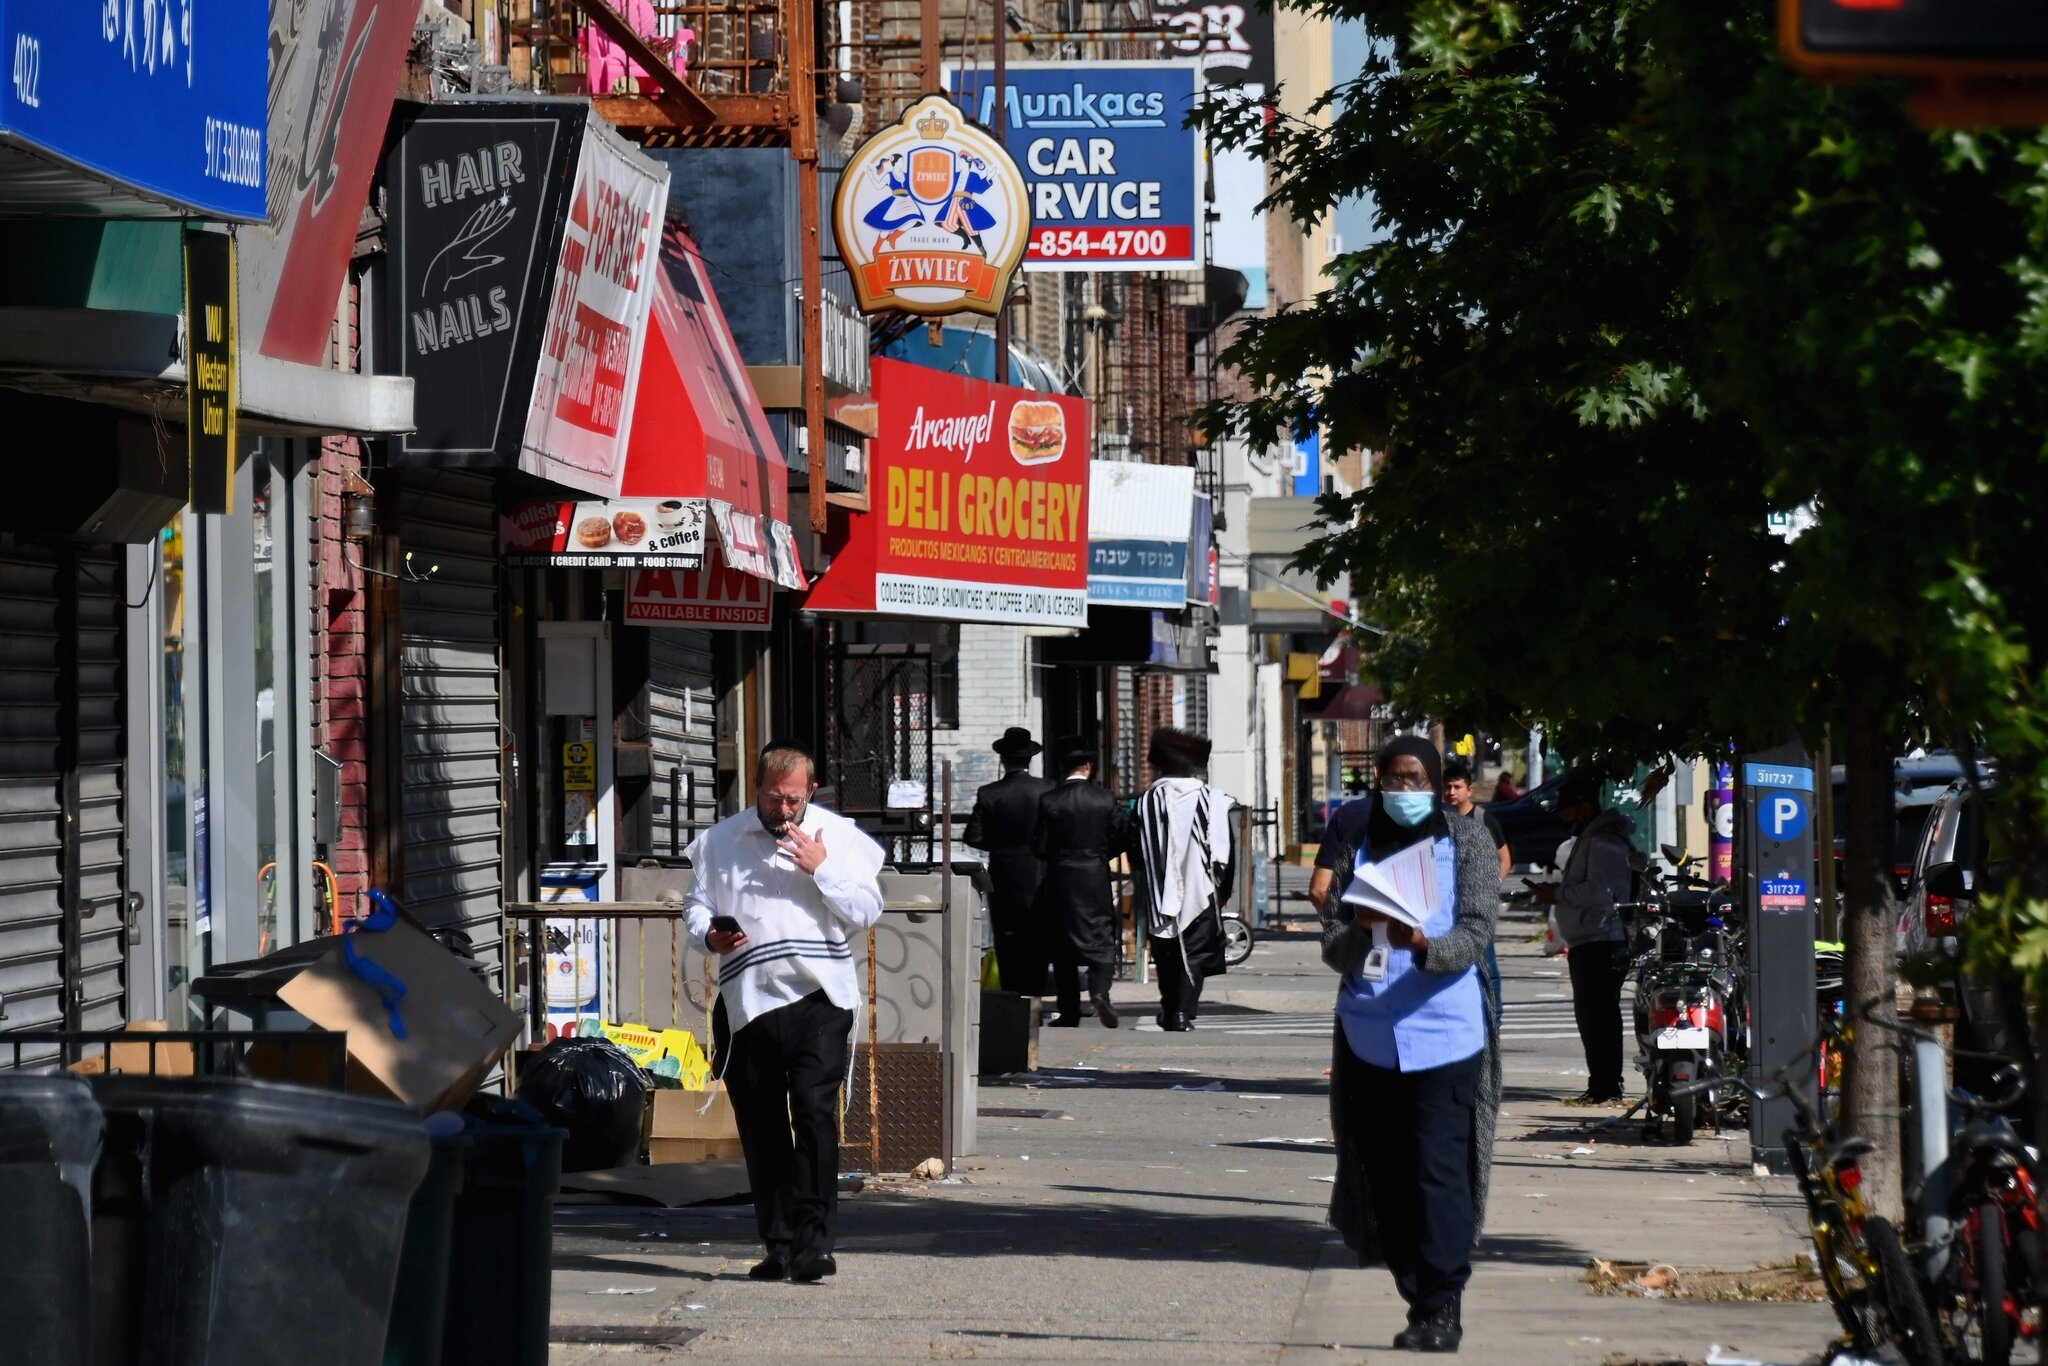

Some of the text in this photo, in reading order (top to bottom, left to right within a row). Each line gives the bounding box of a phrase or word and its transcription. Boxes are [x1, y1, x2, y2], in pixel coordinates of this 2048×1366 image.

[13, 32, 39, 108] 4022
[979, 82, 1168, 129] Munkacs
[1026, 137, 1117, 176] CAR
[419, 140, 527, 210] HAIR
[916, 171, 947, 182] ŻYWIEC
[1029, 181, 1161, 220] RVICE
[585, 179, 651, 293] FOR SALE
[909, 236, 950, 244] TRADE MARK
[888, 256, 971, 283] ŻYWIEC
[411, 286, 511, 356] NAILS
[196, 352, 227, 392] Western
[202, 395, 223, 436] Union
[905, 399, 996, 463] Arcangel
[887, 466, 1082, 542] DELI GROCERY
[660, 529, 700, 549] coffee
[889, 537, 1077, 571] PRODUCTOS MEXICANOS Y CENTROAMERICANOS
[1095, 548, 1131, 565] שבת
[523, 556, 555, 567] ACCEPT
[556, 556, 587, 567] CREDIT
[588, 556, 611, 567] CARD
[617, 557, 635, 567] ATM
[643, 557, 666, 568] FOOD
[666, 557, 699, 569] STAMPS
[630, 603, 765, 623] AVAILABLE INSIDE
[881, 581, 898, 602] COLD
[899, 583, 915, 604] BEER
[922, 586, 939, 606] SODA
[942, 587, 983, 610] SANDWICHES
[985, 591, 998, 611] HOT
[999, 591, 1022, 613] COFFEE
[1025, 593, 1046, 614] CANDY
[1053, 596, 1062, 615] ICE
[1063, 597, 1084, 617] CREAM
[1757, 772, 1794, 785] 311737
[1774, 798, 1799, 834] P
[1767, 885, 1800, 895] 311737
[620, 1032, 657, 1047] Villita
